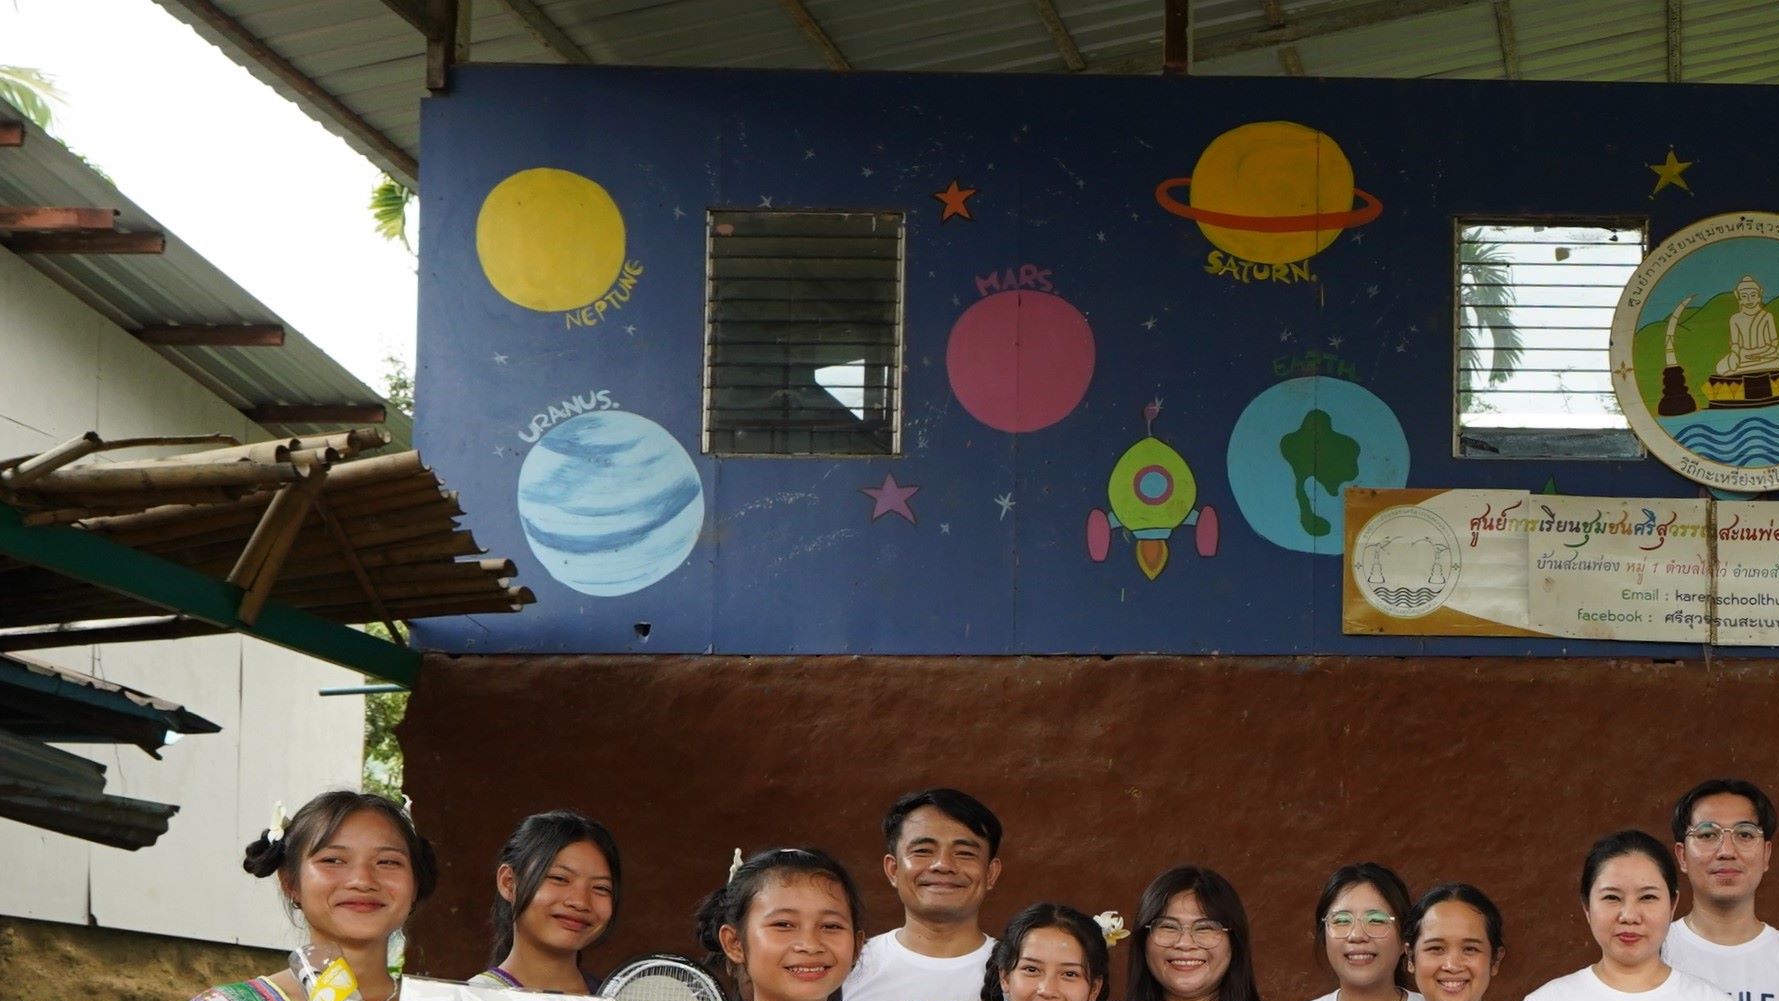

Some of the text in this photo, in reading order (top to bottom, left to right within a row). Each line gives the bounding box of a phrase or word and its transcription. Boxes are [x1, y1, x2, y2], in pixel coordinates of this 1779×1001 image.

[565, 259, 644, 331] NEPTUNE
[1621, 588, 1659, 601] Email
[1577, 608, 1643, 623] facebook
